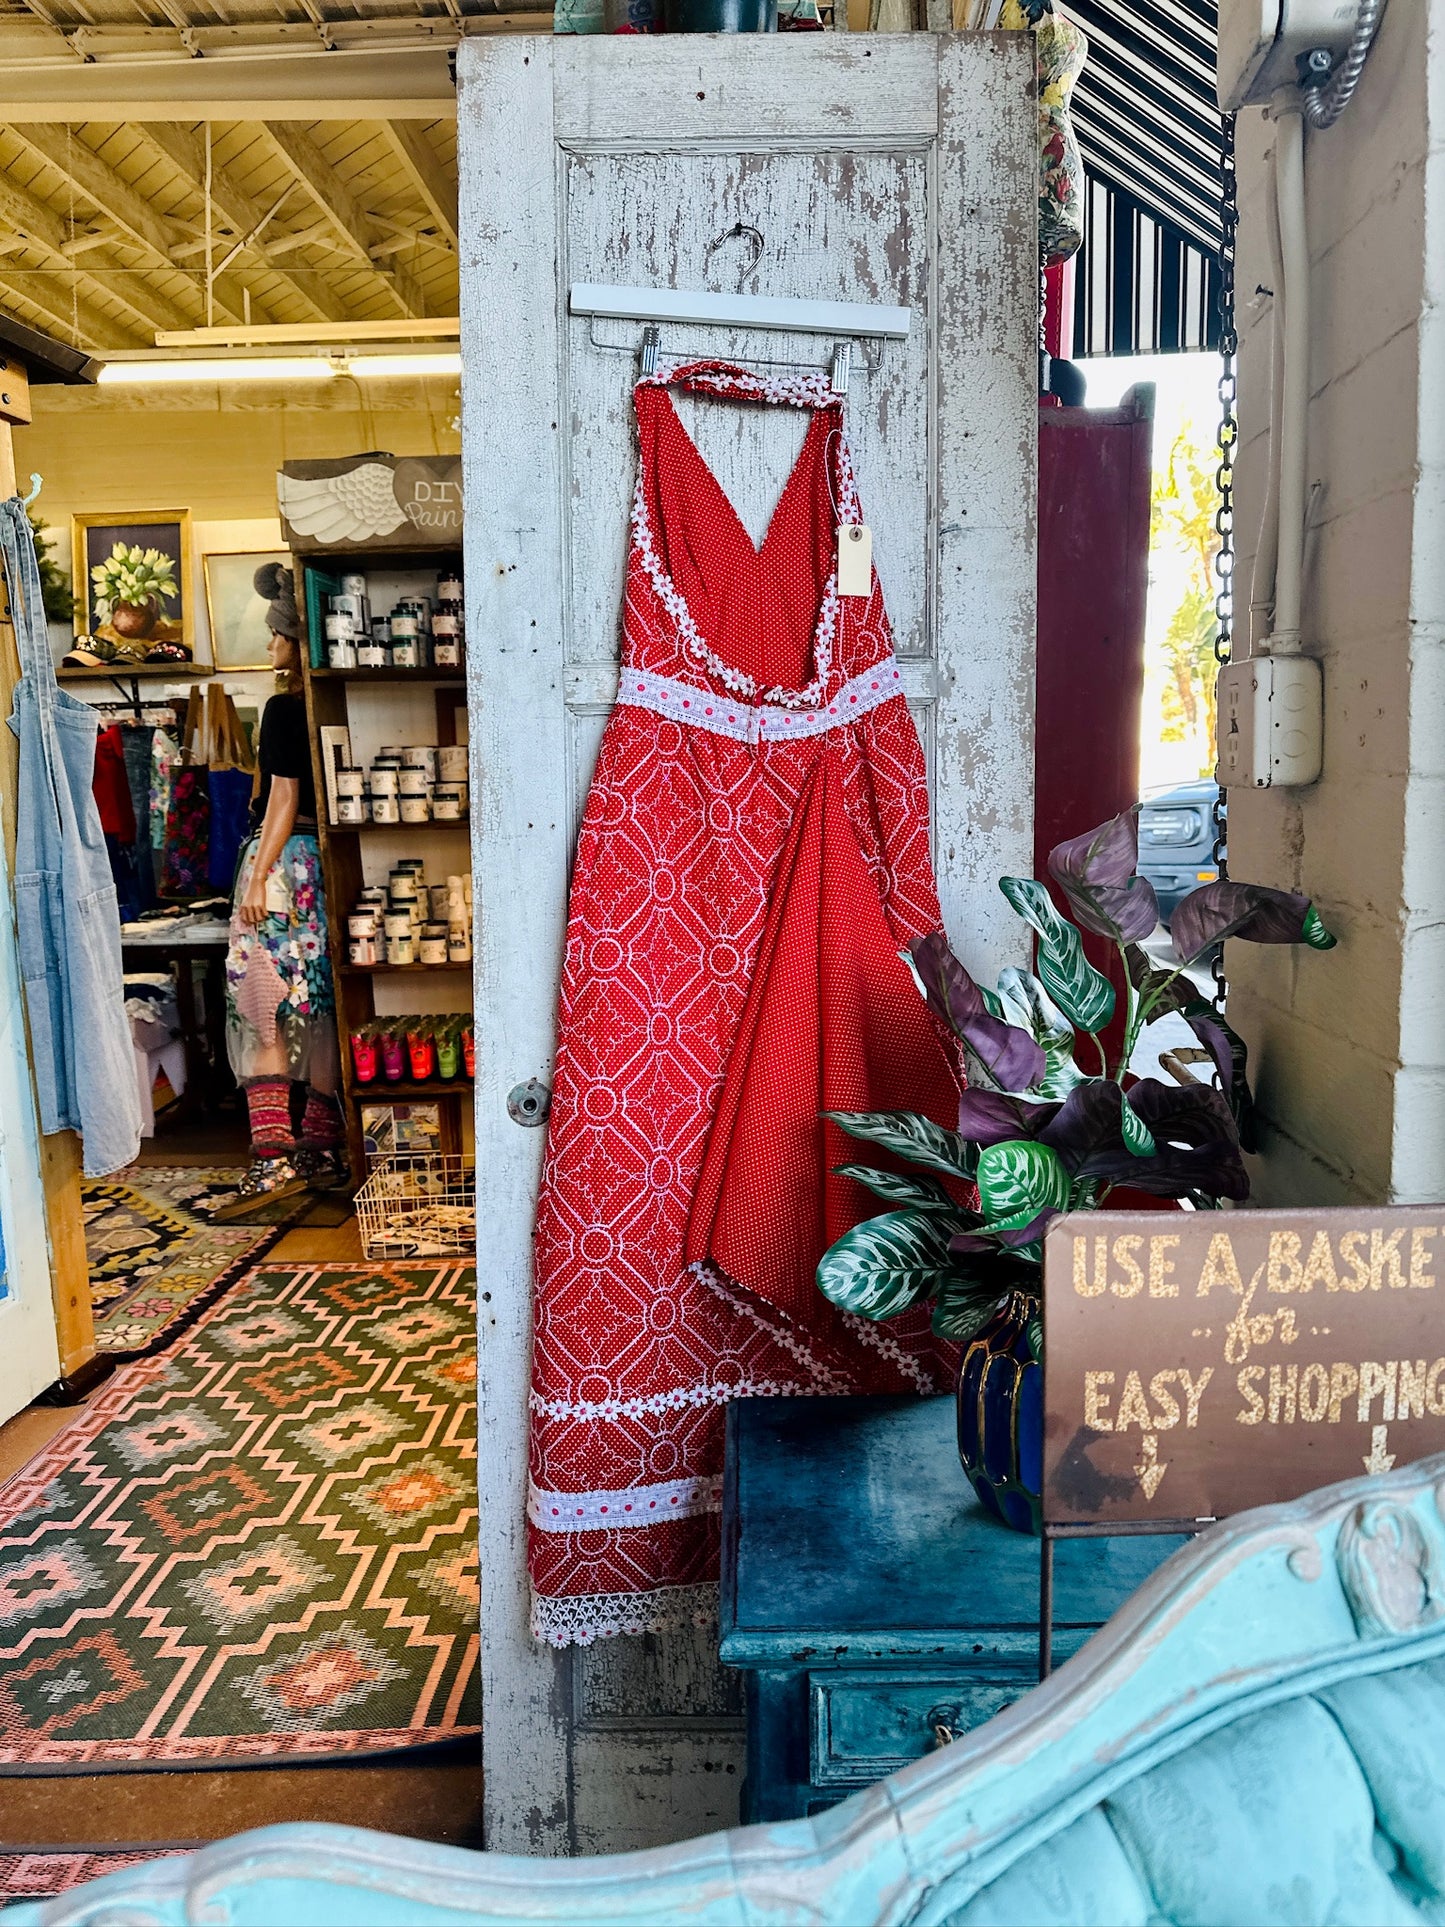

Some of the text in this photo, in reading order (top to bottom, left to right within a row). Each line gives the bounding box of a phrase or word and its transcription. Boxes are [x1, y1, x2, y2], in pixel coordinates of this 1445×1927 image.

[404, 501, 463, 531] Pain
[1072, 1227, 1445, 1298] USE A BASKE
[1223, 1261, 1299, 1364] for
[1084, 1360, 1445, 1433] EASY SHOPPING
